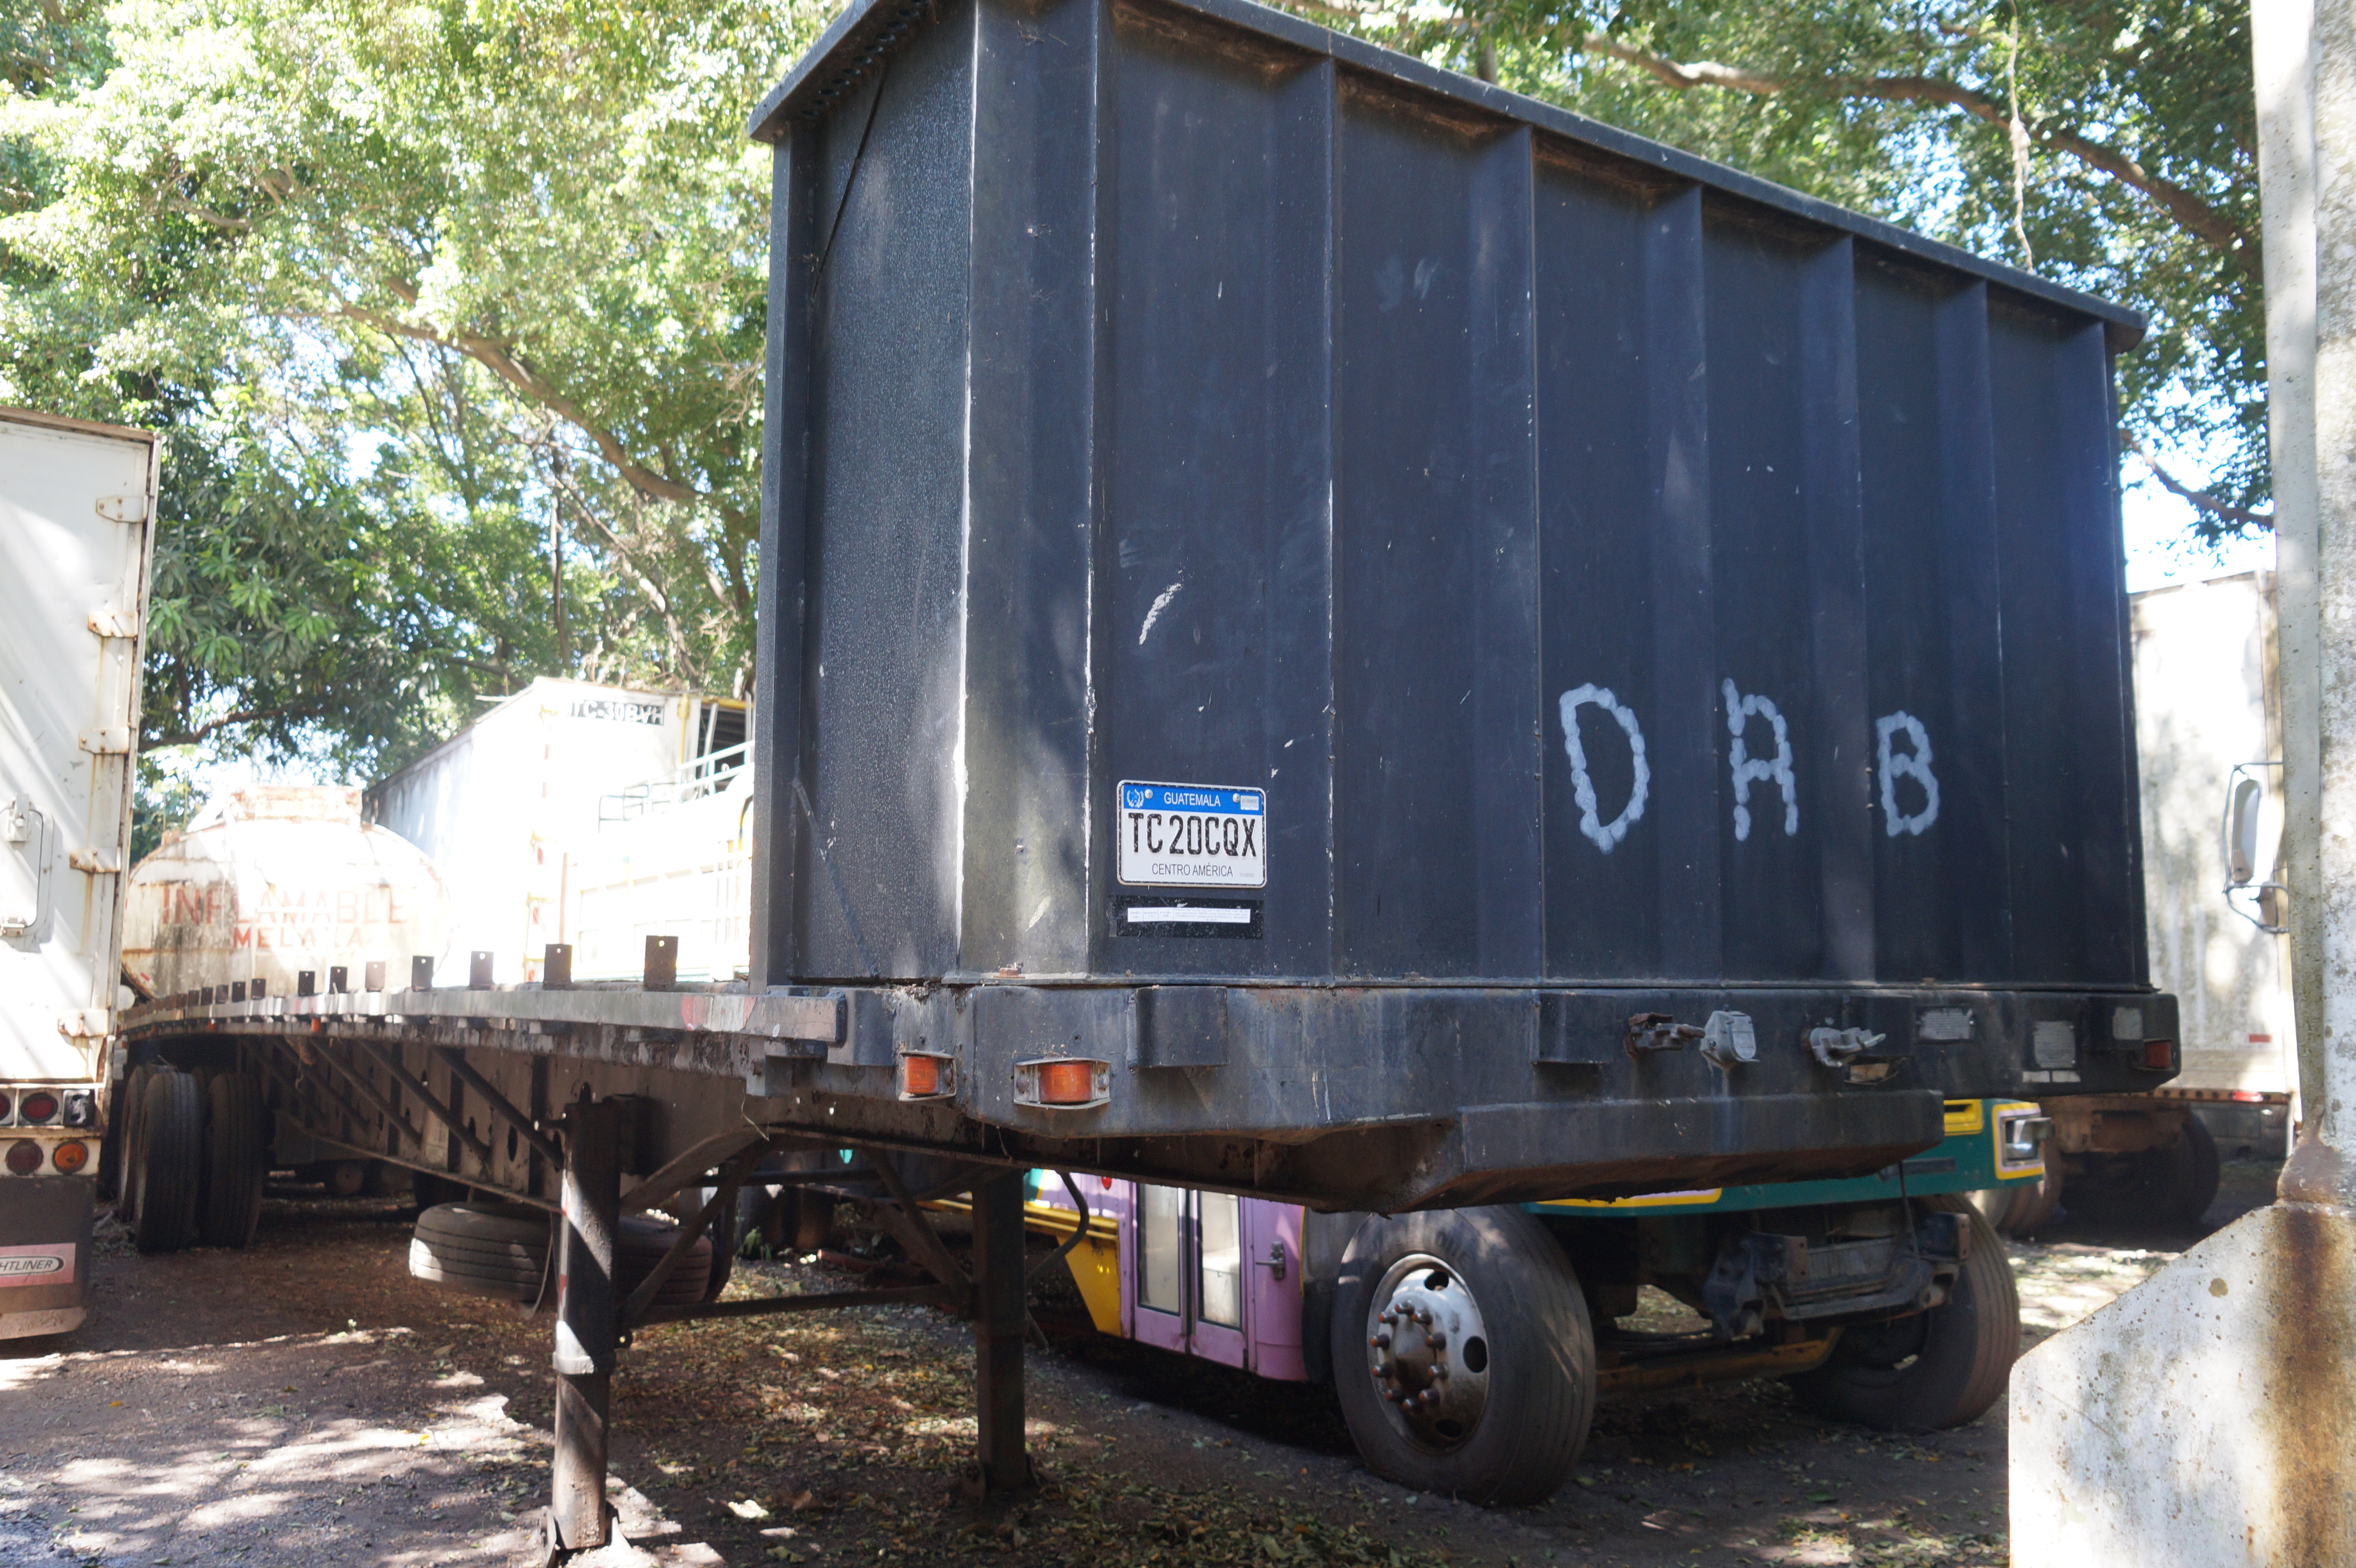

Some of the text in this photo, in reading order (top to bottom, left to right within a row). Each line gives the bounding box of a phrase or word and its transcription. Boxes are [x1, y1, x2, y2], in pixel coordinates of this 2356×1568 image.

[1164, 792, 1221, 807] GUATEMALA
[1152, 862, 1233, 877] CENTRO AMÉRICA
